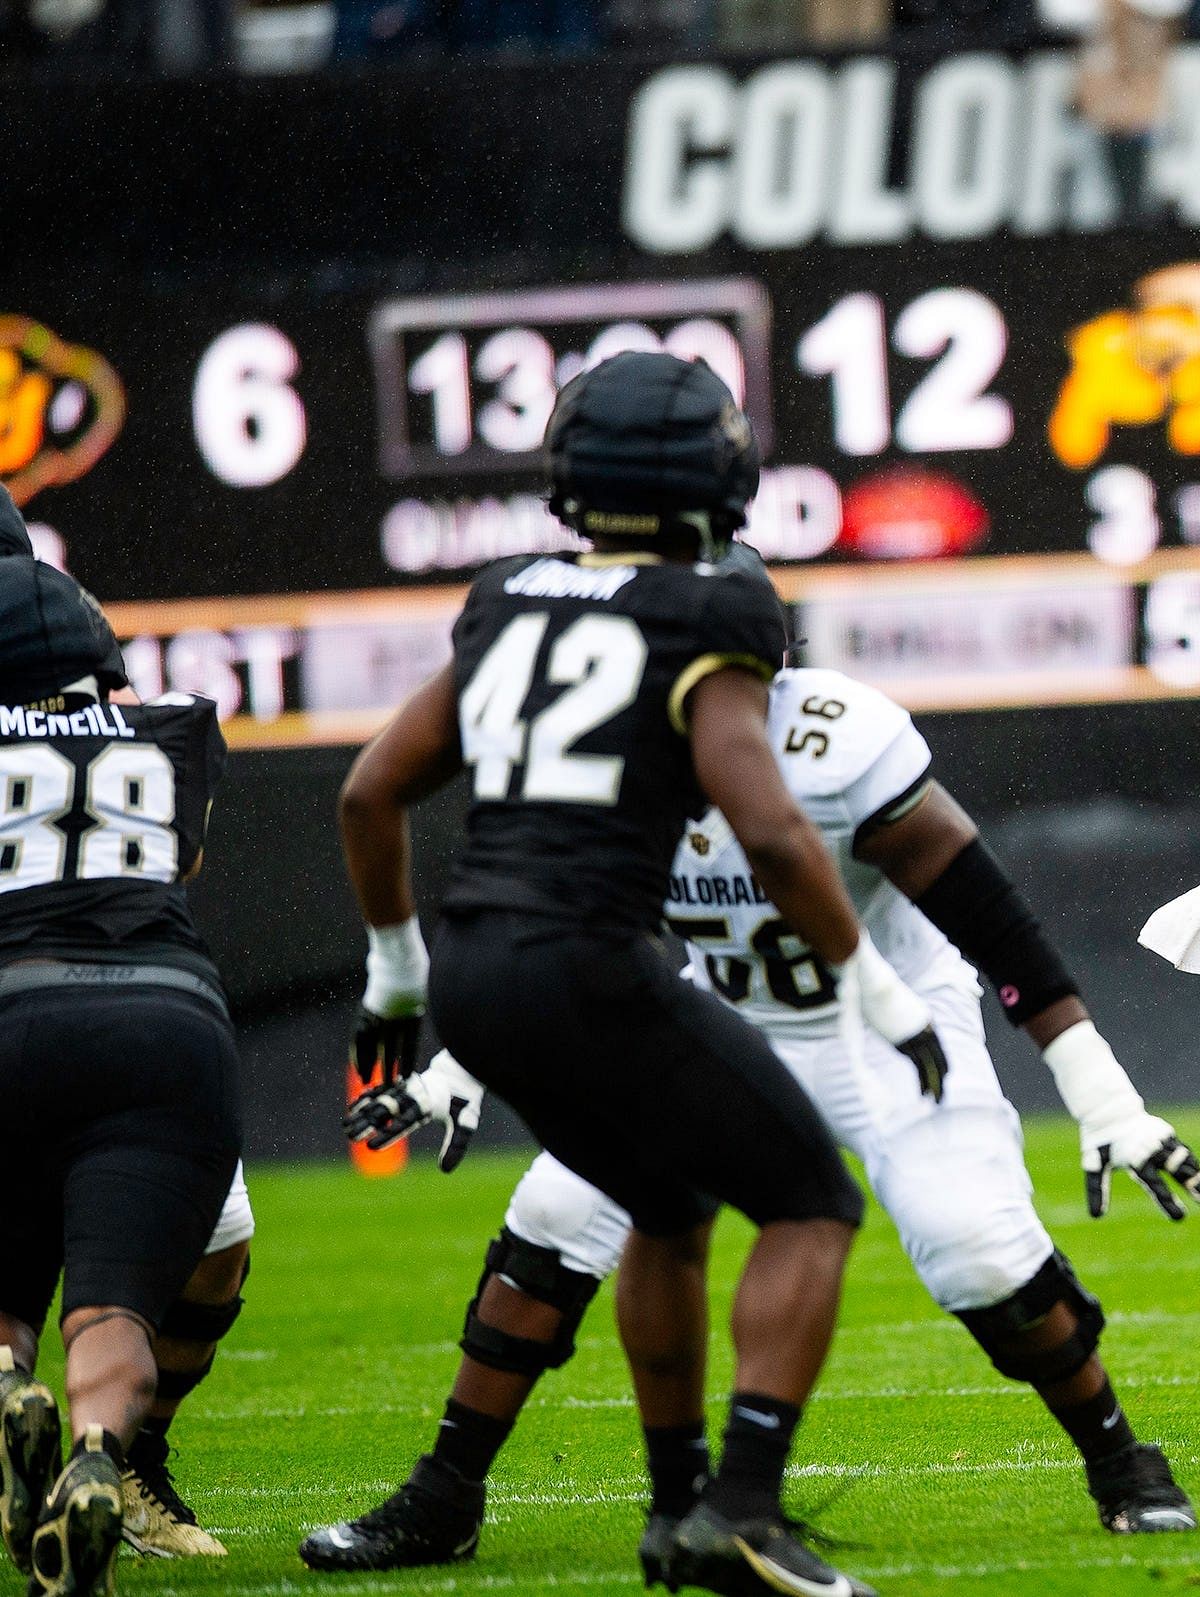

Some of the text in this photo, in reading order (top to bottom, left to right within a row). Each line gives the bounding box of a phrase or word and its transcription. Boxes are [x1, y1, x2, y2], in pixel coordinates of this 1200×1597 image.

[193, 321, 307, 488] 6
[795, 285, 1014, 456] 12
[1086, 466, 1159, 566] 3
[458, 611, 650, 808] 42
[783, 695, 848, 761] 56
[0, 739, 179, 892] 88
